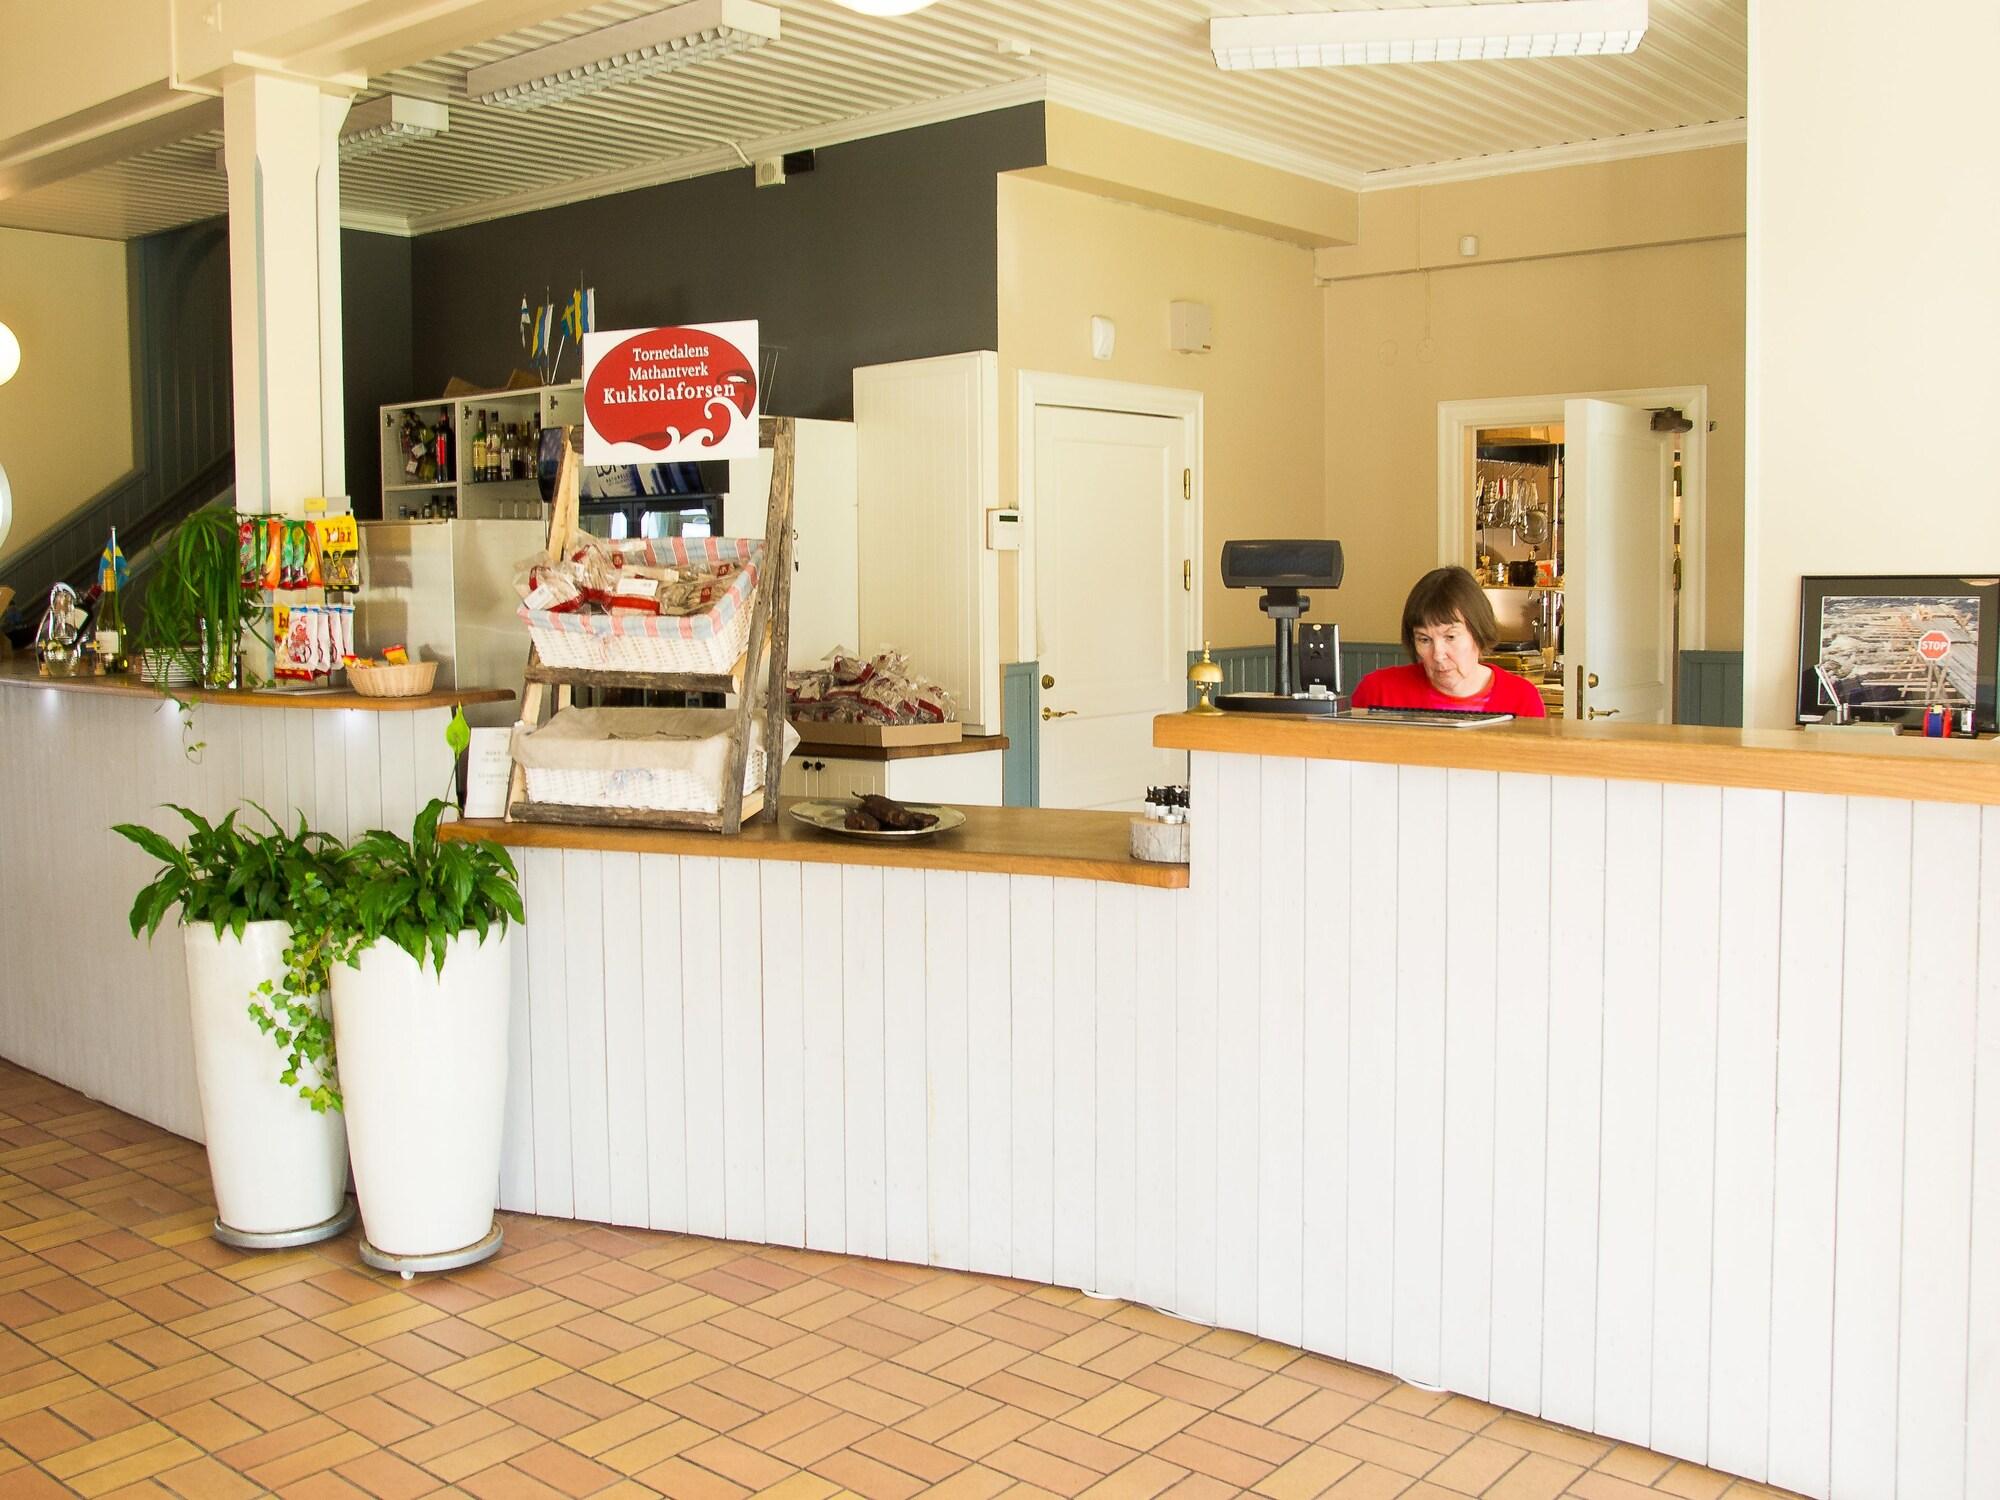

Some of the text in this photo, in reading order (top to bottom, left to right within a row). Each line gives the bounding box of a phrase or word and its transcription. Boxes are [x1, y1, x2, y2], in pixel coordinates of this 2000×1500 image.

[632, 344, 709, 361] Tornedalens
[629, 362, 709, 380] Mathantverk
[603, 381, 735, 405] Kukkolaforsen
[1921, 640, 1948, 651] STOP
